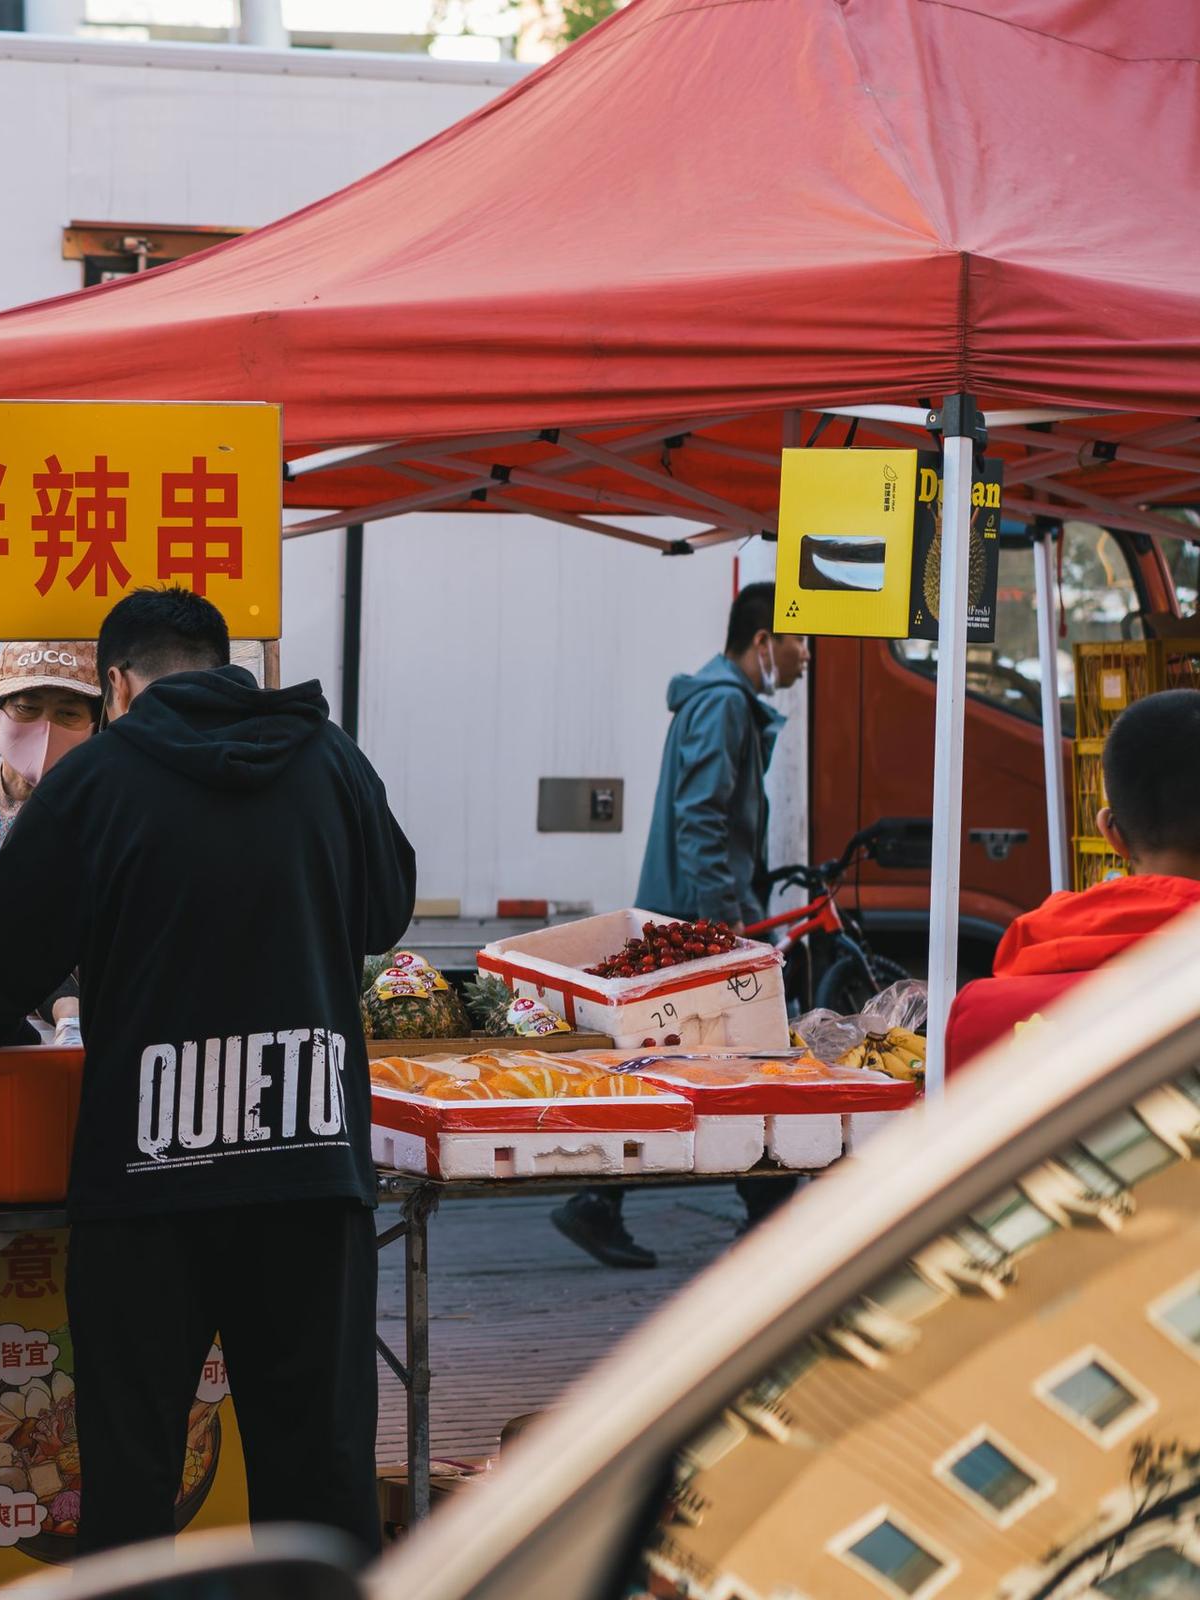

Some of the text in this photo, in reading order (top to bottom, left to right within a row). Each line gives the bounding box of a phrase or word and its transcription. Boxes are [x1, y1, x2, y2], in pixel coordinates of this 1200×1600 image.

[918, 468, 1000, 508] Dan
[17, 650, 78, 668] GUCCI
[651, 1002, 678, 1028] 29
